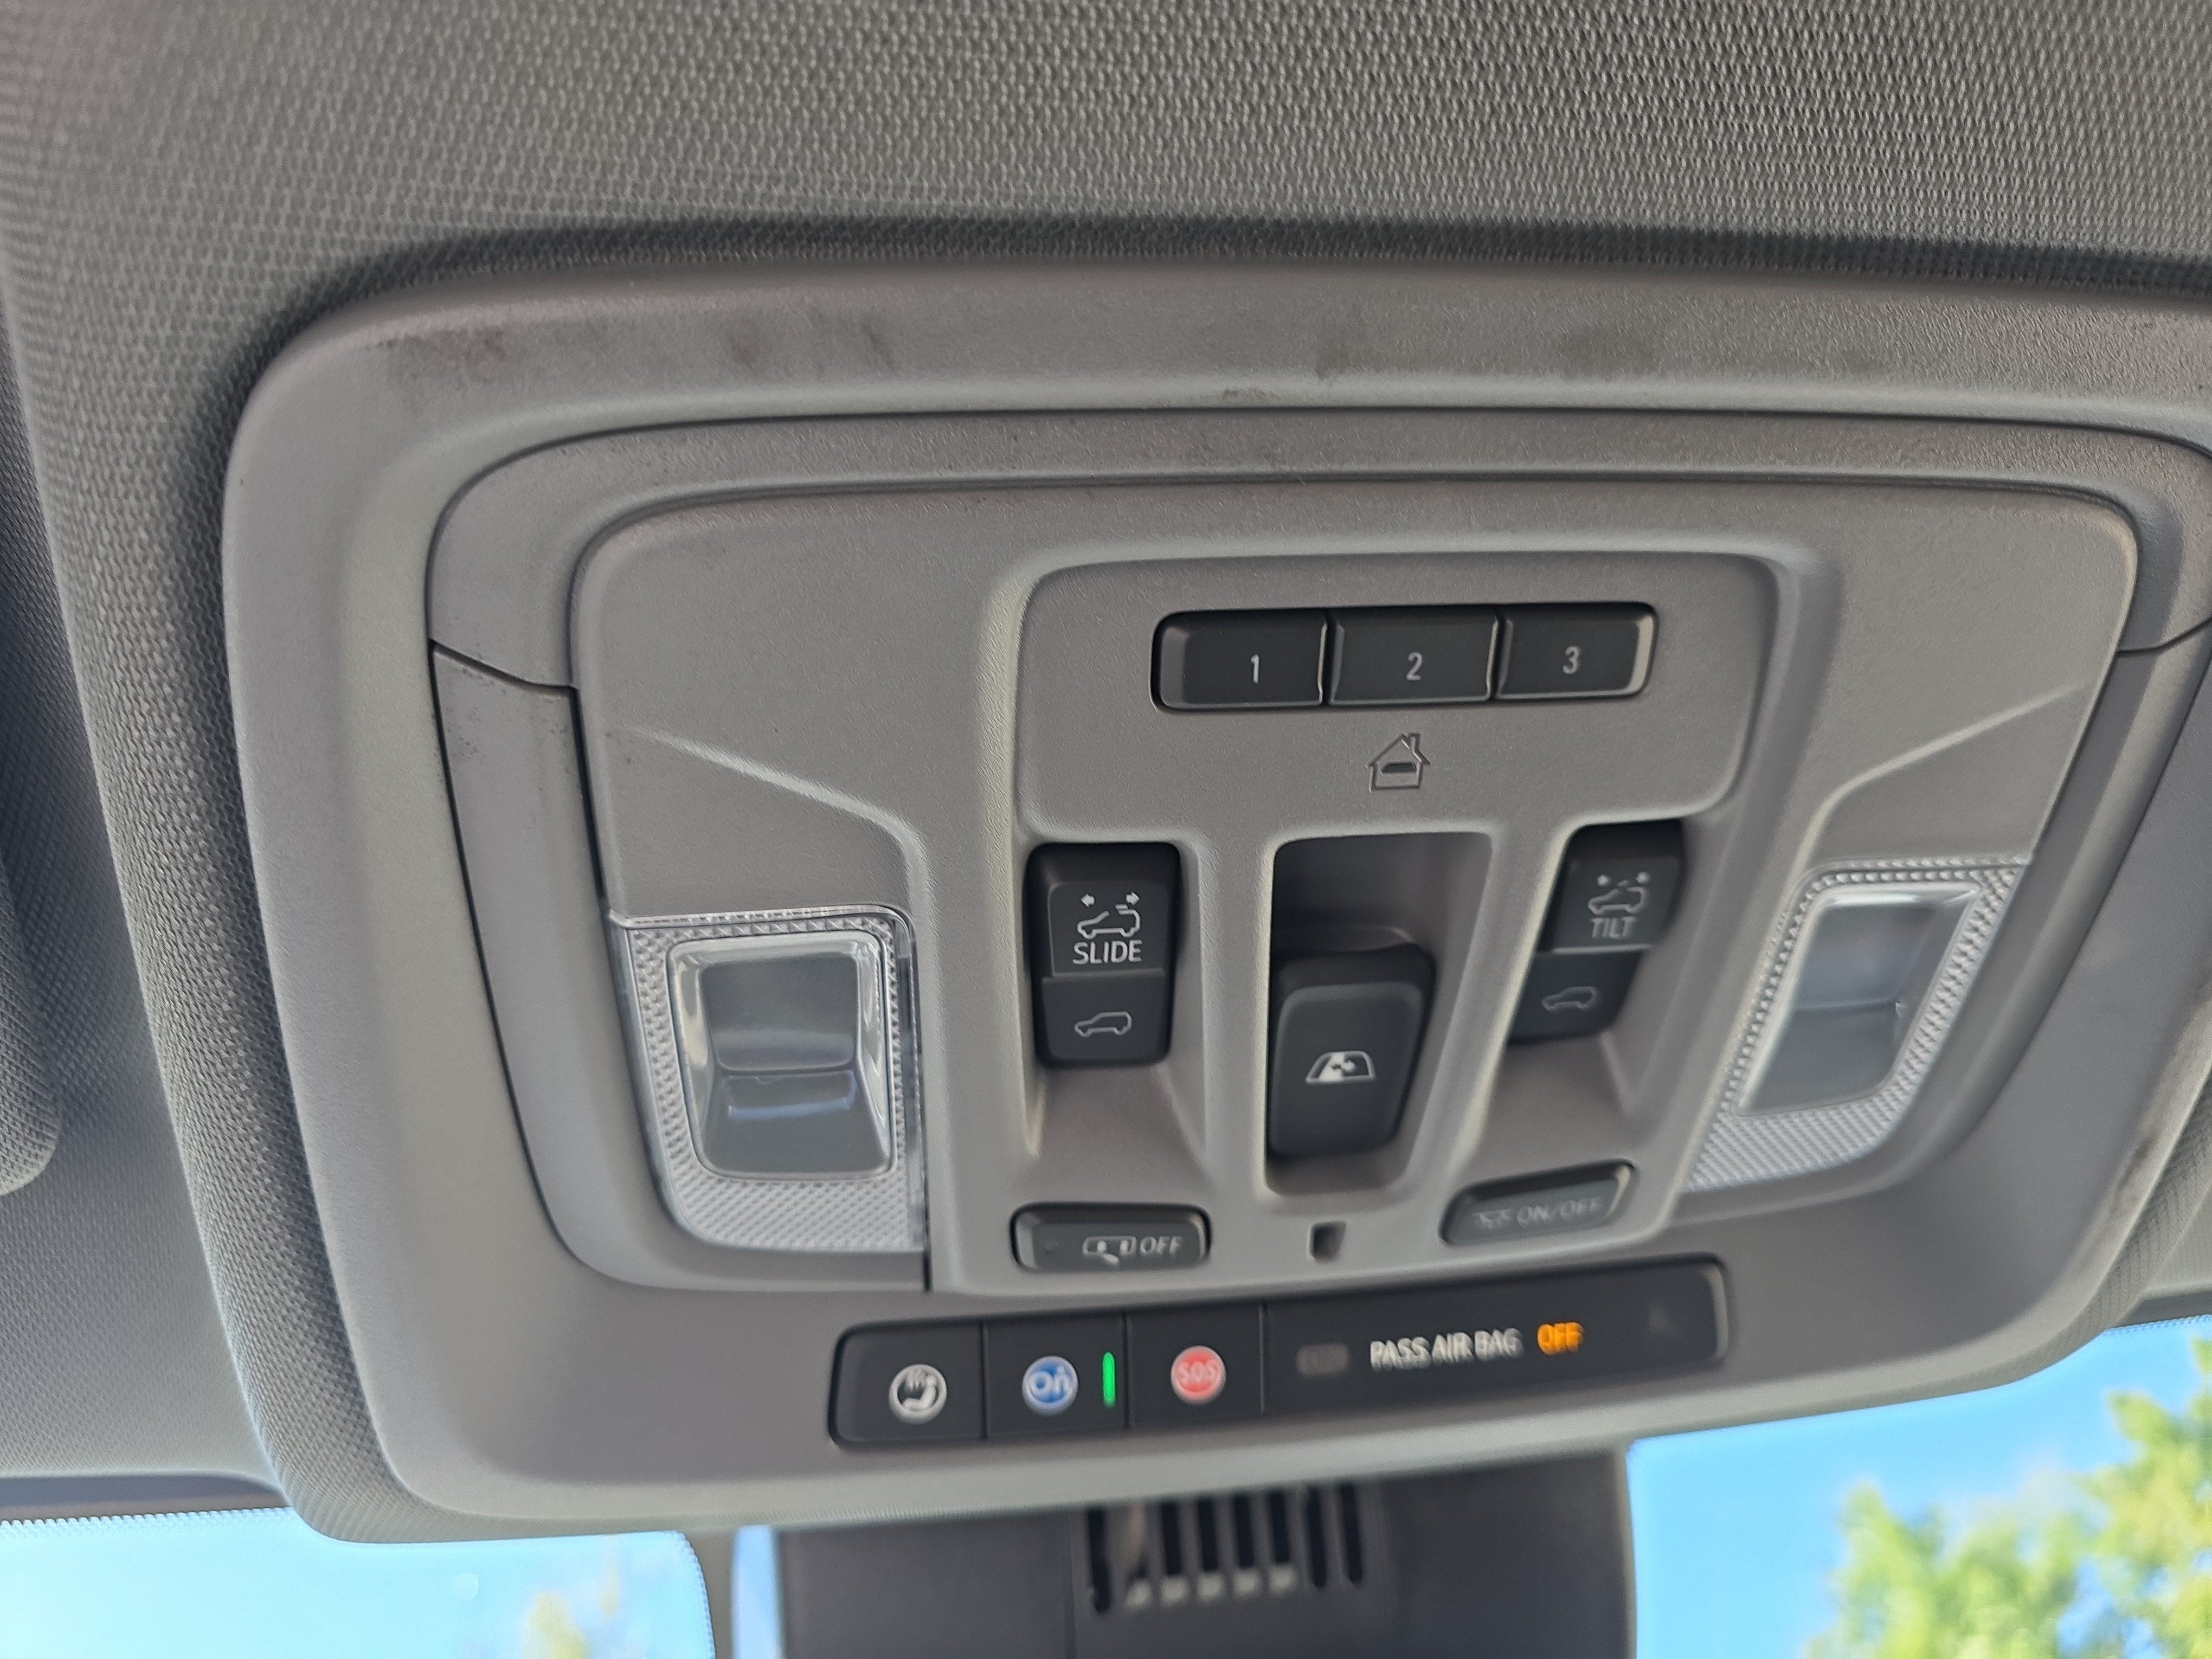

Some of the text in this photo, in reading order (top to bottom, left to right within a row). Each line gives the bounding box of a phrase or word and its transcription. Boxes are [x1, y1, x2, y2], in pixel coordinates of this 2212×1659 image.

[1250, 654, 1260, 683] 1
[1406, 652, 1422, 680] 2
[1562, 646, 1580, 674] 3
[1591, 916, 1636, 939] TILT
[1073, 940, 1142, 964] SLIDE
[1140, 1236, 1182, 1255] OFF
[1370, 1336, 1431, 1371] PASS
[1431, 1332, 1474, 1364] AIR
[1474, 1328, 1522, 1361] BAG
[1537, 1322, 1583, 1355] OFF
[1177, 1360, 1219, 1385] SOS
